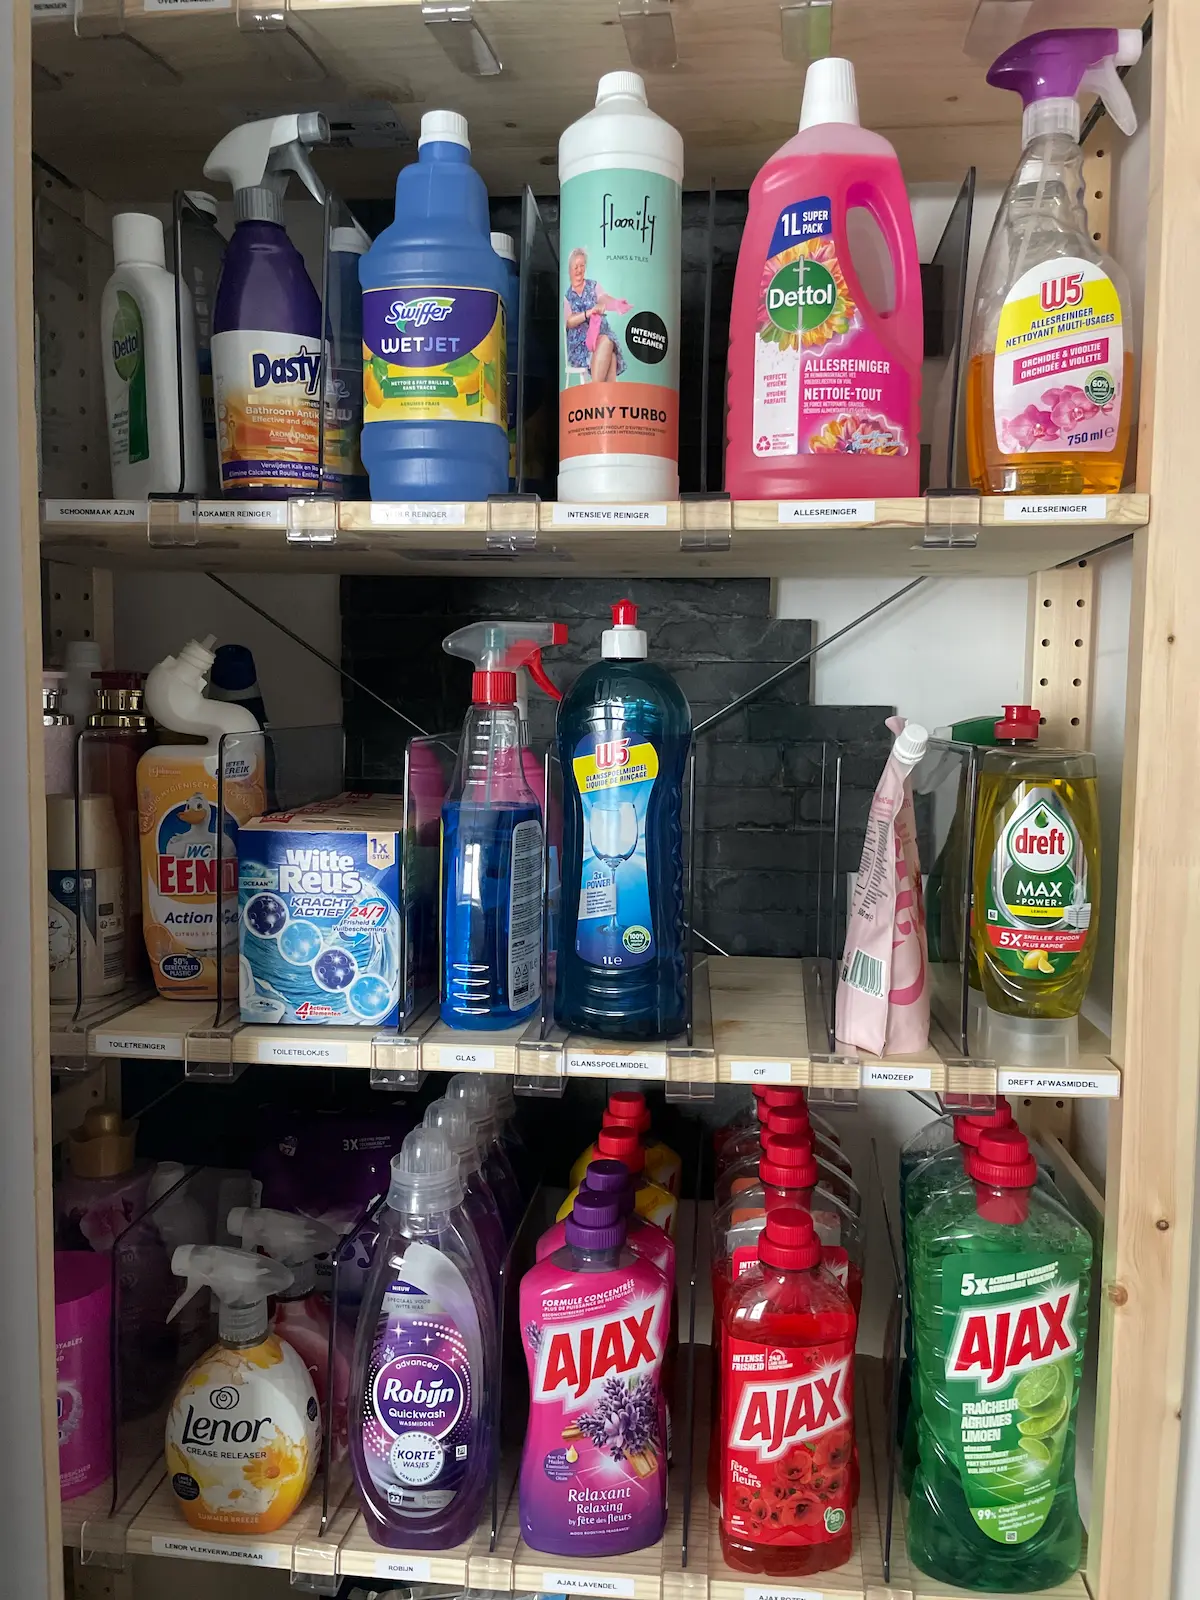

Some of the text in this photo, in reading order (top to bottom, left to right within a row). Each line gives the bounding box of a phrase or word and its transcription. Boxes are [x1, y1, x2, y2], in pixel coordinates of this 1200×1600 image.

[802, 210, 829, 222] SUPER
[782, 213, 801, 237] 1L
[802, 223, 824, 234] PACK
[769, 284, 832, 310] Dettol
[1040, 272, 1084, 312] W5
[385, 300, 452, 328] Swiffer
[1030, 307, 1094, 331] ALLESREINIGER
[631, 326, 666, 344] INTENSIVE
[1005, 313, 1115, 348] NETTOYANT MULTI-USAGES
[113, 330, 138, 360] Dettol
[632, 336, 664, 351] CLEANER
[1021, 352, 1060, 369] ORCHIDEE
[1070, 342, 1101, 356] VIOOLTJE
[252, 348, 322, 393] Dasty
[804, 359, 890, 375] ALLESREINIGER
[1020, 353, 1102, 380] ORCHIDÉE & VIOLETTE
[1092, 380, 1109, 389] 60%
[803, 387, 883, 401] NETTOIE-TOUT
[246, 407, 295, 417] Bathroom
[568, 406, 667, 423] CONNY TURBO
[252, 416, 300, 426] Effective and
[1067, 429, 1103, 446] 750 ml
[59, 508, 112, 516] SCHOONMAAK
[567, 511, 650, 520] INTENSIEVE REINIGER
[793, 508, 858, 517] ALLESREINIGER
[1020, 505, 1087, 514] ALLESREINIGER
[596, 738, 631, 769] W5
[585, 763, 648, 782] GLANSSPOELMIDDEL
[586, 779, 609, 789] LIQUIDE
[619, 771, 648, 783] RINÇAGE
[370, 838, 388, 854] 1x
[1015, 827, 1065, 855] dreft
[187, 844, 212, 859] WC
[286, 849, 354, 872] Witte
[278, 864, 362, 895] Reus
[586, 879, 611, 890] POWER
[1016, 880, 1063, 898] MAX
[291, 897, 355, 907] KRACHT
[1021, 898, 1058, 907] POWER
[164, 910, 213, 925] Action
[293, 908, 345, 917] ACTIEF
[350, 906, 386, 920] 24/7
[333, 926, 387, 935] Vuilbescherming
[999, 932, 1023, 947] 5X
[1023, 933, 1052, 941] SNELLER
[1022, 941, 1039, 949] PLUS
[173, 957, 189, 965] 50%
[108, 1041, 166, 1051] TOILETREINIGER
[272, 1048, 330, 1057] TOILETBLOKJES
[455, 1054, 477, 1062] GLAS
[570, 1060, 649, 1069] GLANSSPOELMIDDEL
[753, 1068, 766, 1076] CIF
[871, 1073, 914, 1082] HANDZEEP
[1007, 1078, 1099, 1089] DREFT AFWASMIDDEL
[342, 1138, 359, 1151] 3X
[542, 1278, 636, 1307] FORMULE CONCENTRÉE
[566, 1300, 597, 1310] PUISSANCE
[954, 1293, 1071, 1384] AJAX
[542, 1304, 657, 1400] AJAX
[732, 1353, 765, 1363] INTENSE
[395, 1359, 440, 1371] advanced
[731, 1362, 765, 1372] FRISHEID
[383, 1378, 455, 1409] Robijn
[388, 1407, 446, 1420] Quickwash
[739, 1369, 842, 1453] AJAX
[962, 1398, 1019, 1415] FRAÎCHEUR
[181, 1404, 272, 1446] Lenor
[961, 1413, 1013, 1429] AGRUMES
[961, 1428, 1001, 1443] LIMOEN
[186, 1446, 267, 1460] CREASE RELEASER
[397, 1450, 436, 1461] KORTE
[399, 1471, 416, 1483] VANAF
[423, 1461, 441, 1481] MINUTEN
[403, 1461, 430, 1469] WASJES
[730, 1459, 749, 1476] fête
[732, 1469, 762, 1489] fleurs
[568, 1486, 632, 1502] Relaxant
[576, 1502, 624, 1514] Relaxing
[977, 1509, 997, 1521] 99%
[198, 1512, 260, 1524] SUMMER BREEZE
[568, 1518, 577, 1526] by
[577, 1515, 595, 1527] fête
[607, 1512, 632, 1525] fleurs
[165, 1543, 264, 1560] LENOR VLEKVERWIJDERAAR
[388, 1565, 414, 1573] ROBIJN
[556, 1579, 618, 1590] AJAX LAVENDEL
